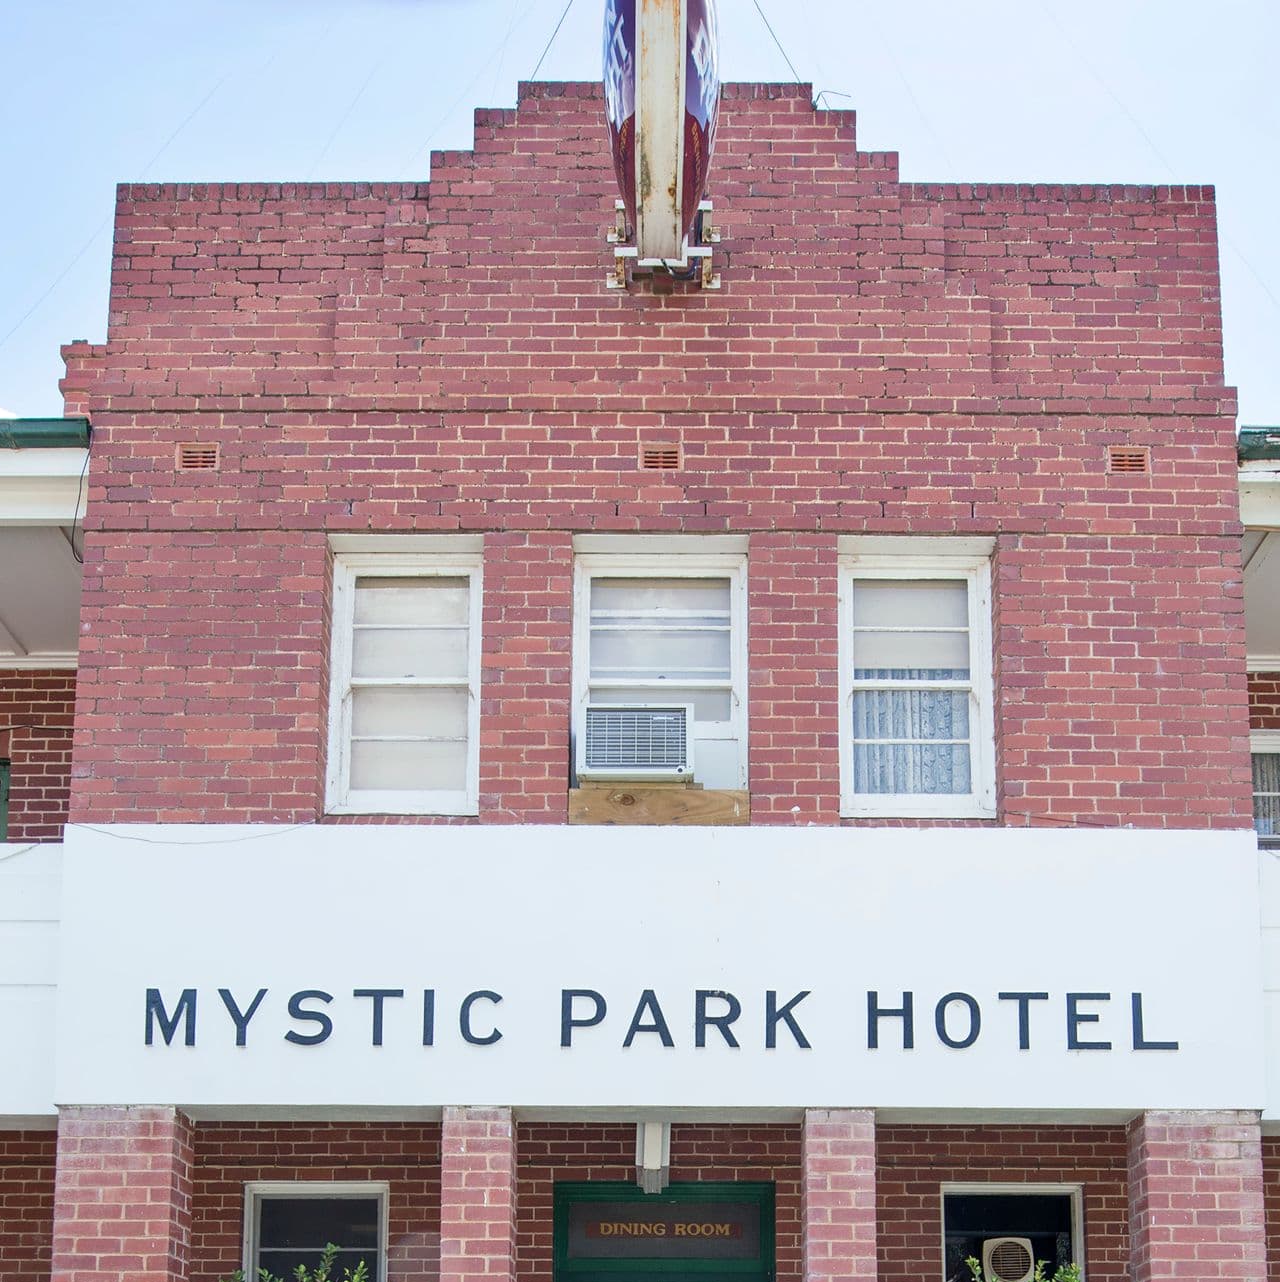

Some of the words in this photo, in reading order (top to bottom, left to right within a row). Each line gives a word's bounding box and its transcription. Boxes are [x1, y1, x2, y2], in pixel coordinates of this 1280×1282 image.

[144, 988, 504, 1047] MYSTIC
[560, 988, 812, 1049] PARK
[866, 990, 1179, 1051] HOTEL
[599, 1222, 666, 1236] DINING
[674, 1222, 731, 1236] ROOM
